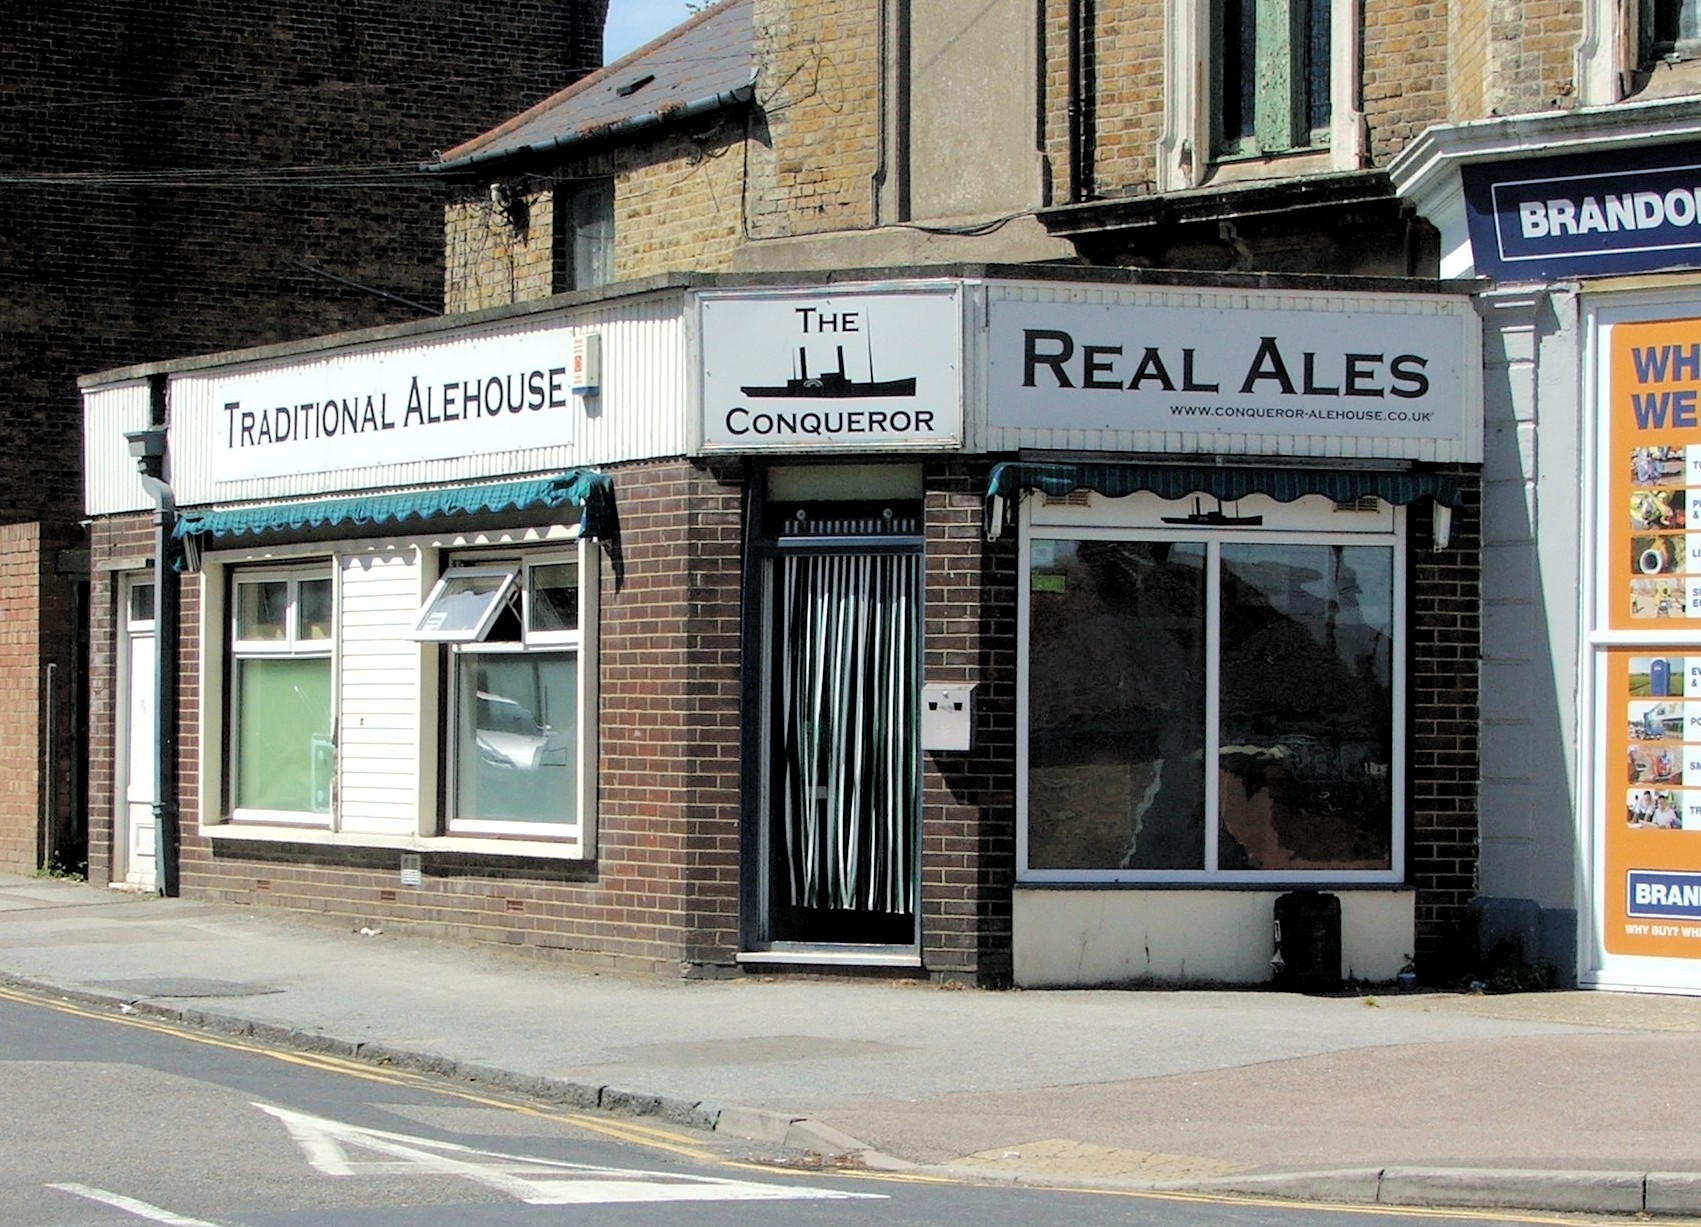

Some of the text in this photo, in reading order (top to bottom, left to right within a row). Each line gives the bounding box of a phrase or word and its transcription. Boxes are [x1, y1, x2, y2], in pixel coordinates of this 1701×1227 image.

[1519, 187, 1701, 238] BRANDO
[795, 307, 859, 333] THE
[1022, 329, 1430, 399] REAL ALES
[224, 366, 567, 449] TRADITIONAL ALEHOUSE
[726, 407, 934, 436] CONQUEROR
[1170, 405, 1431, 423] WWW.CONQUEROR-ALEHOUSE.CO.UK
[1631, 391, 1697, 430] WE
[1635, 883, 1701, 907] BRAN
[1625, 924, 1650, 935] WHY
[1651, 925, 1680, 937] BUY?
